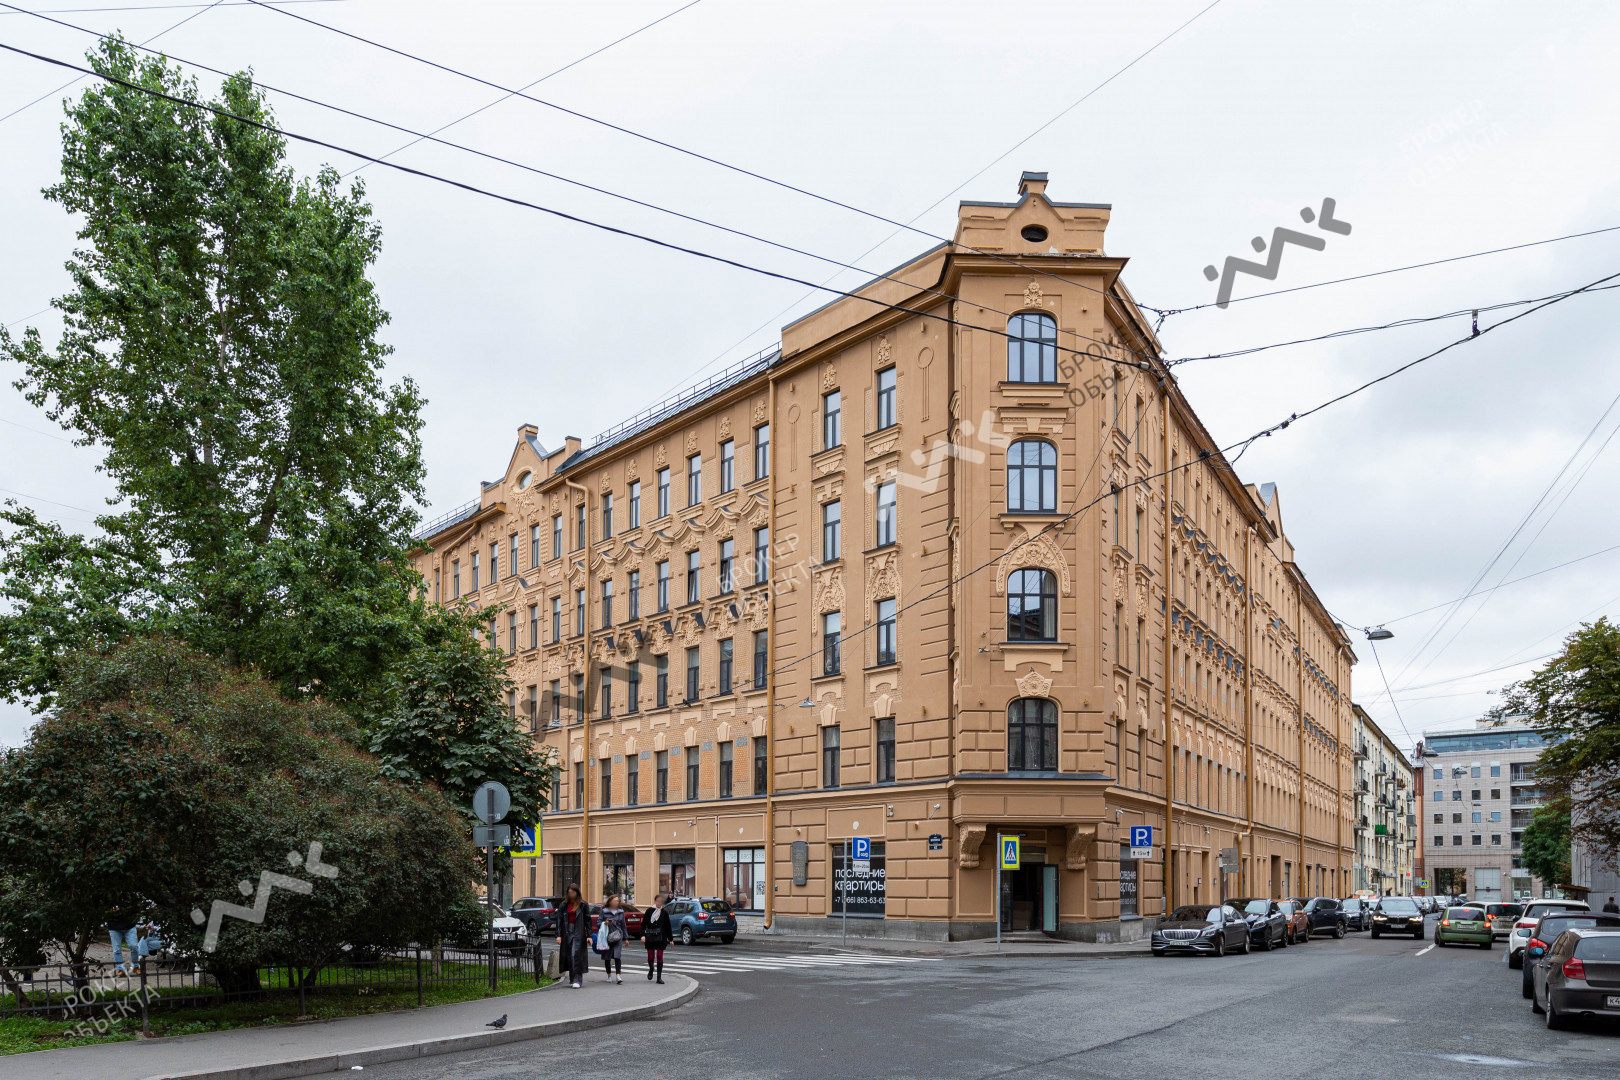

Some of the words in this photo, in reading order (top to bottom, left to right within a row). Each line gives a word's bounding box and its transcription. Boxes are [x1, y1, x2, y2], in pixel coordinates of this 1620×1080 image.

[1135, 828, 1147, 846] P
[857, 839, 867, 857] P
[835, 868, 885, 879] последние
[834, 880, 886, 894] квартиры
